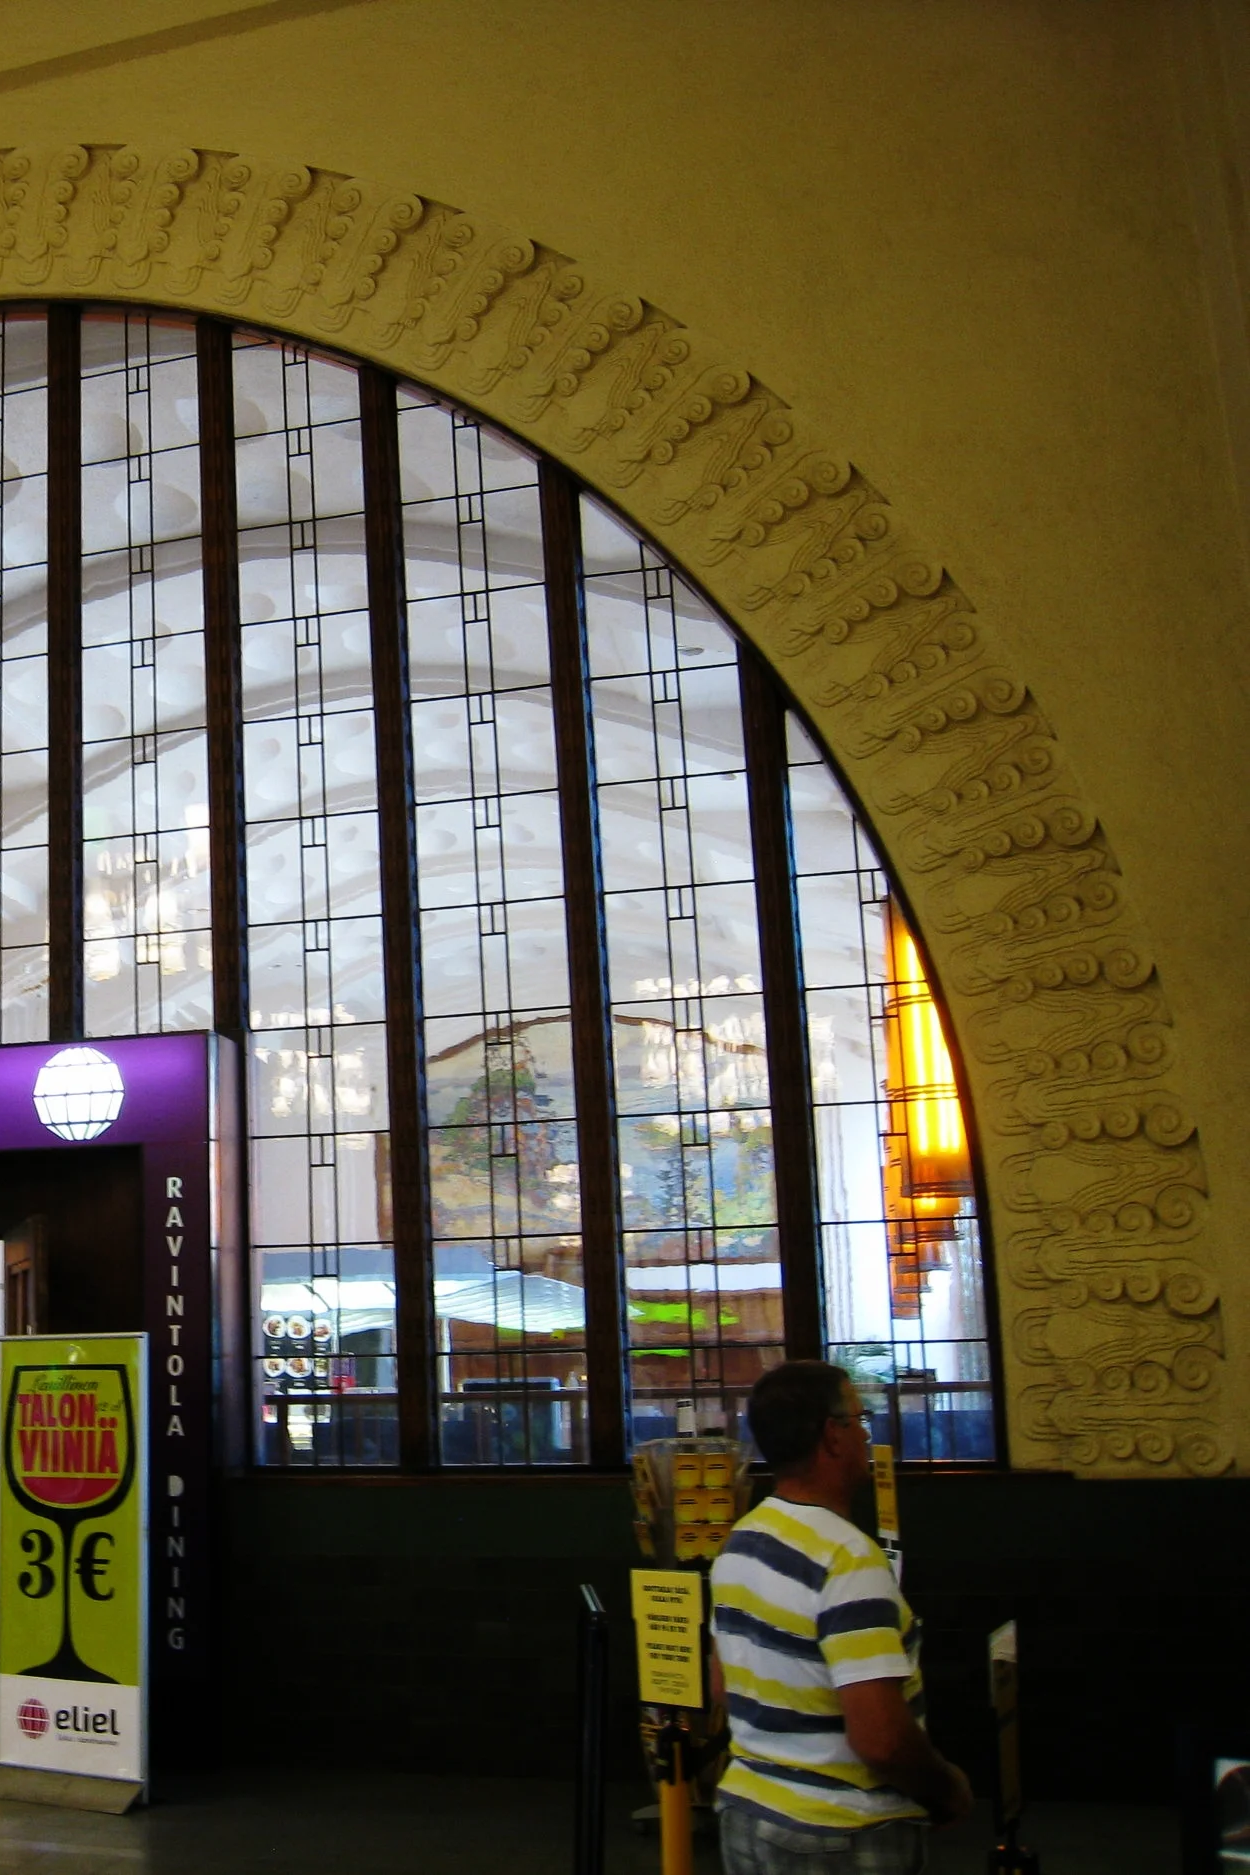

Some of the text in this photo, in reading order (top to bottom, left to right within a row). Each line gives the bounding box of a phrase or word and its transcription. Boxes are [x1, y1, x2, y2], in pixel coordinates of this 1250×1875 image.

[16, 1392, 96, 1428] TALON
[165, 1176, 185, 1650] RAVINTOLA DINING
[17, 1416, 120, 1474] VIINIÄ
[17, 1528, 116, 1601] 3 €
[54, 1705, 121, 1736] eliel
